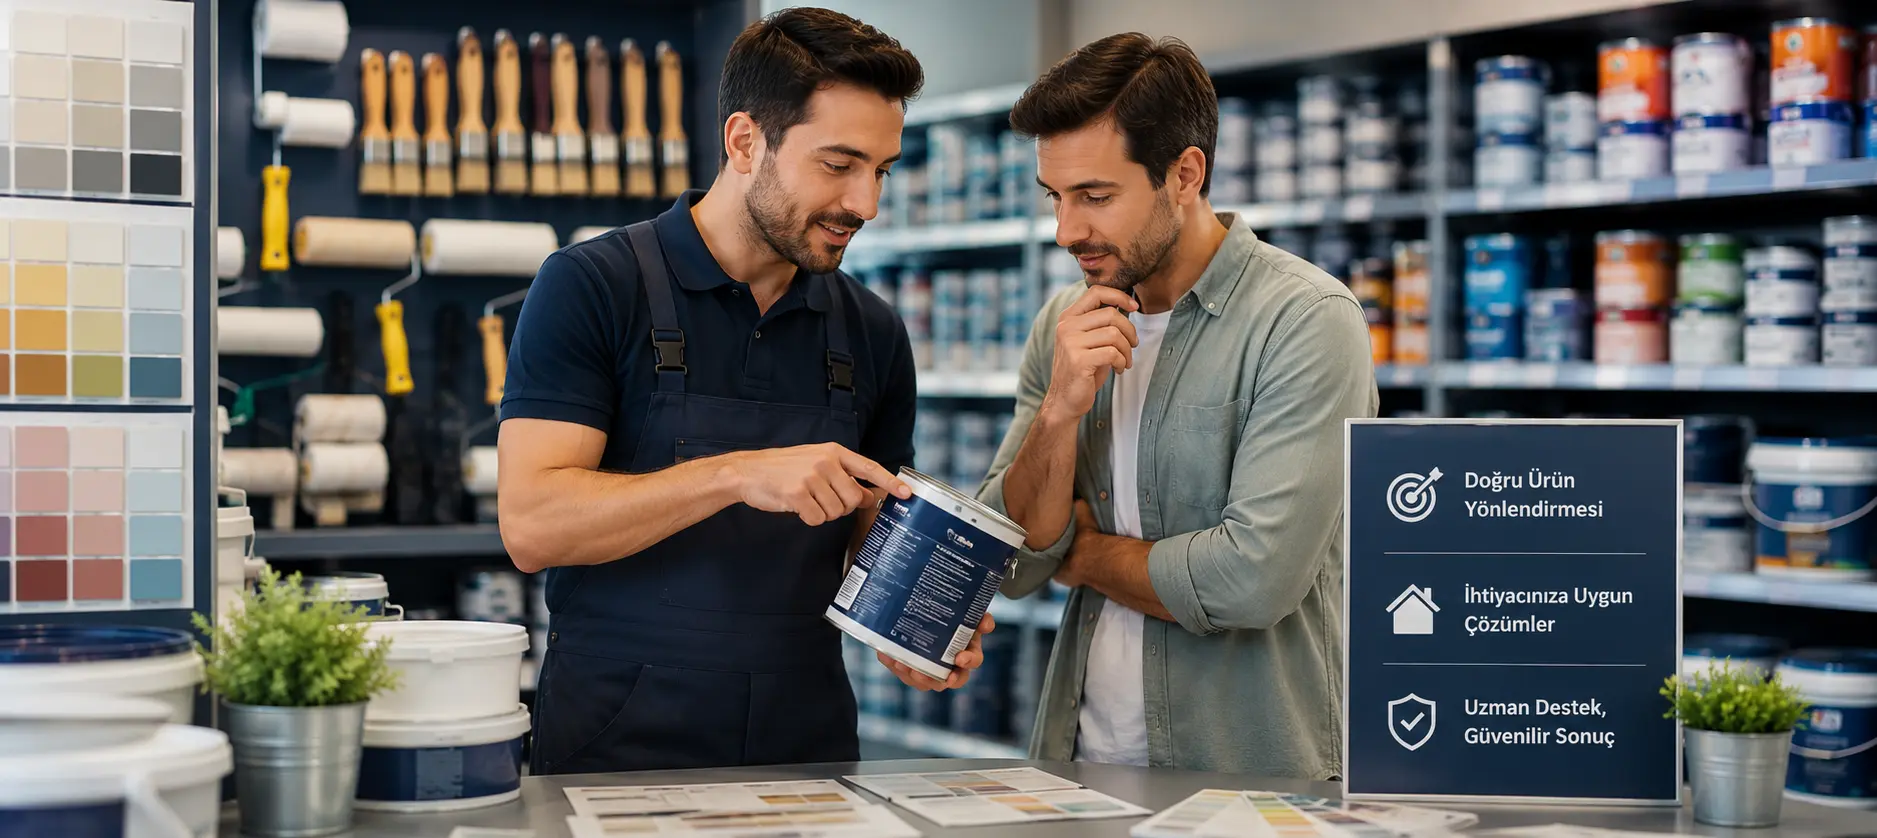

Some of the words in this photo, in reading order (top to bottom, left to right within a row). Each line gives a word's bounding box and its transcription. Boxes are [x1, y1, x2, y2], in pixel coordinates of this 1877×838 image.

[1465, 471, 1523, 493] Doğru
[1528, 467, 1575, 489] Ürün
[1464, 500, 1603, 518] Yönlendirmesi
[1464, 582, 1569, 608] İhtiyacınıza
[1574, 587, 1633, 608] Uygun
[1464, 614, 1556, 637] Çözümler
[1464, 698, 1530, 716] Uzman
[1535, 698, 1607, 719] Destek,
[1464, 726, 1551, 745] Güvenilir
[1555, 727, 1615, 749] Sonuç
